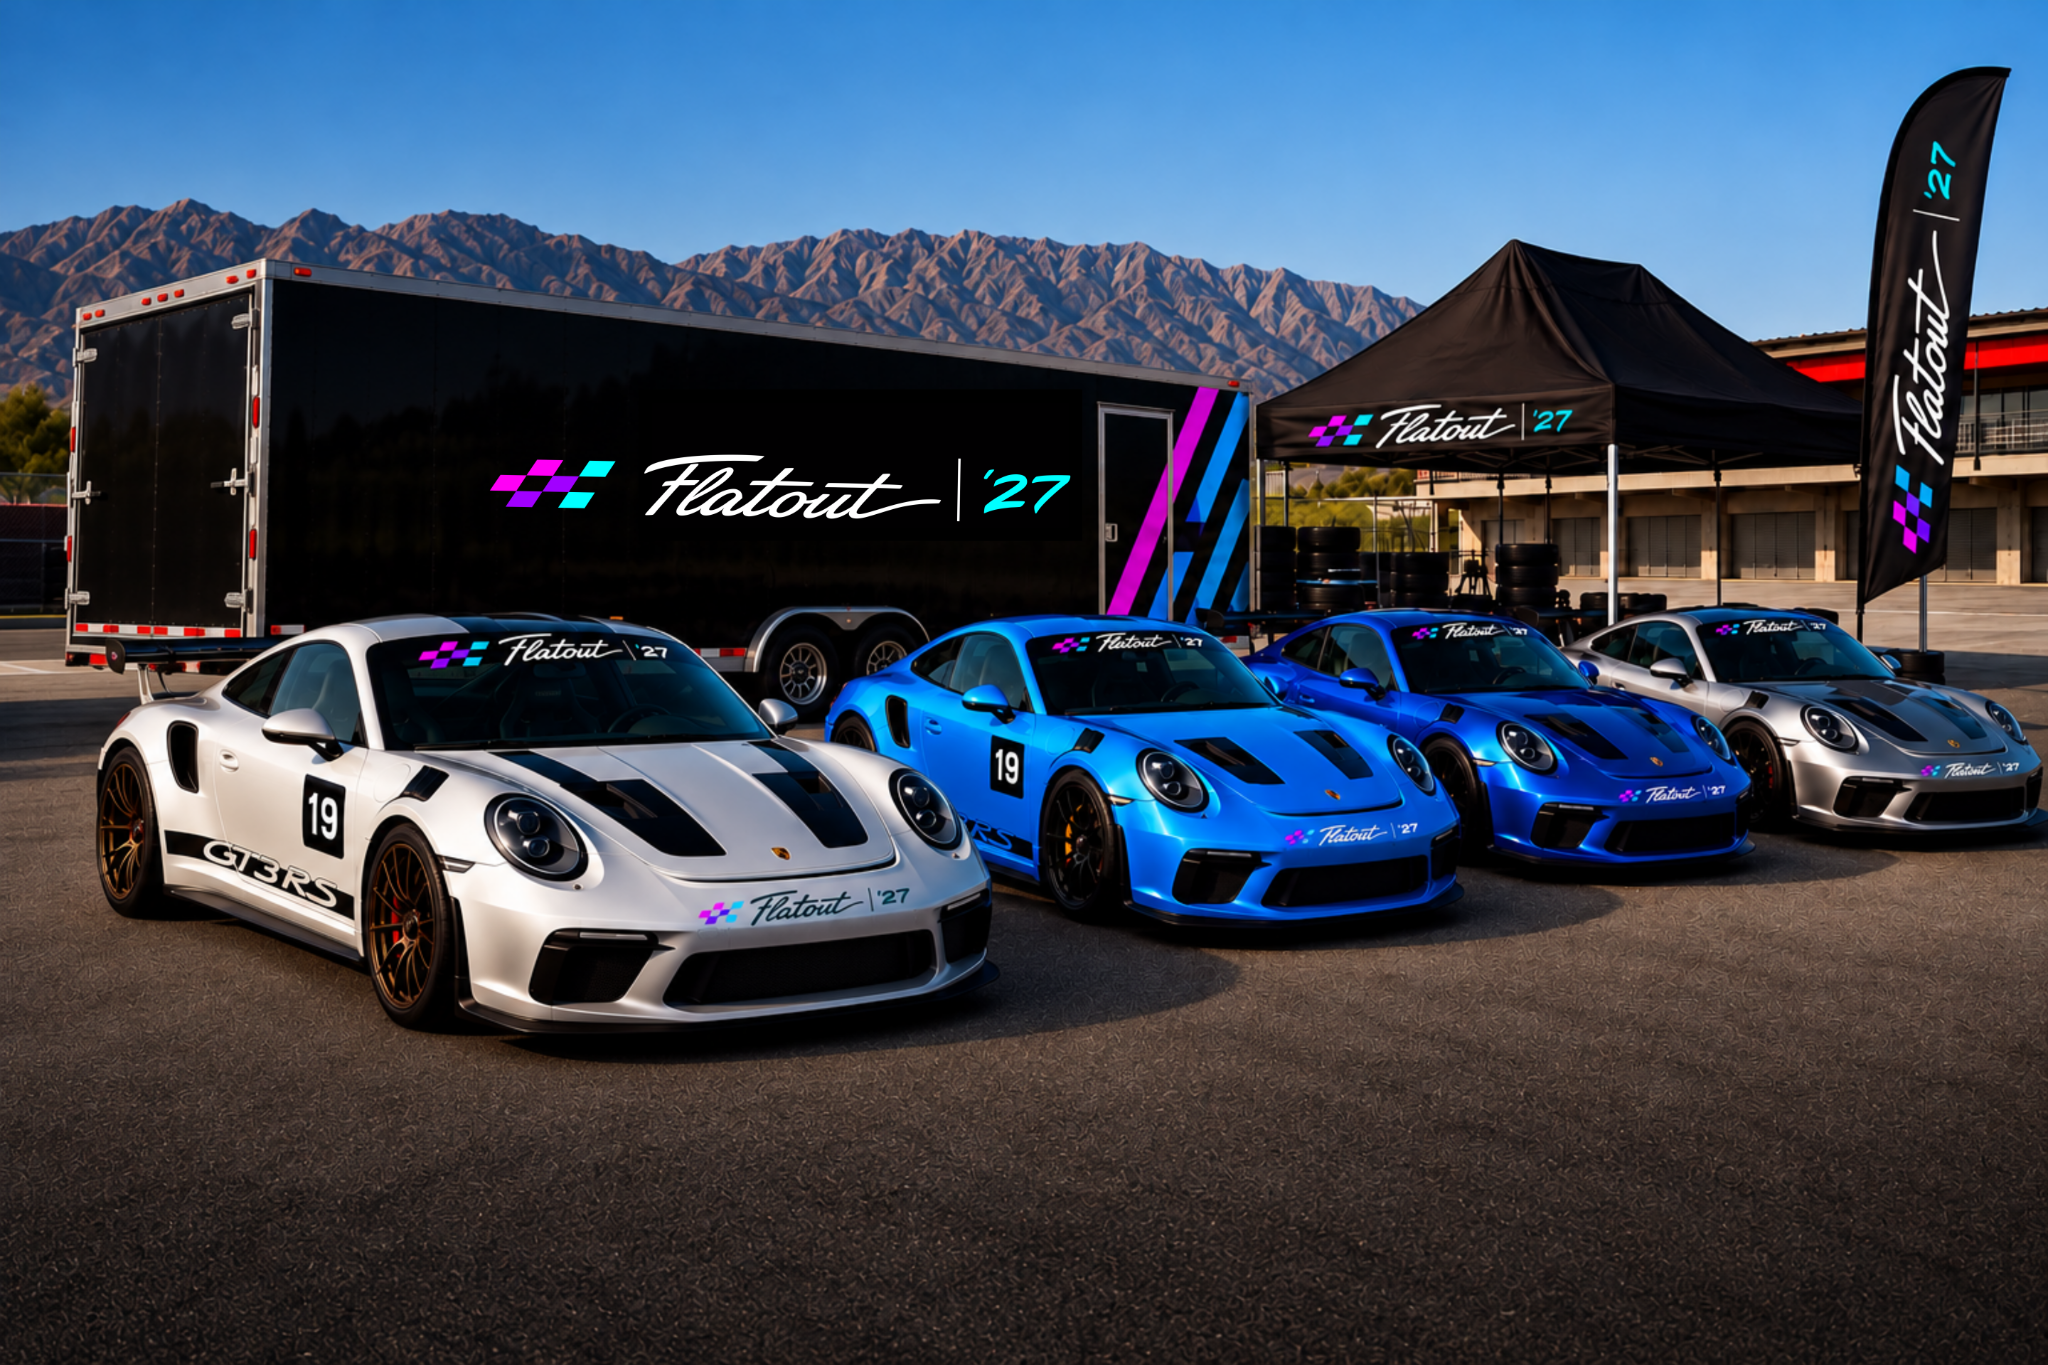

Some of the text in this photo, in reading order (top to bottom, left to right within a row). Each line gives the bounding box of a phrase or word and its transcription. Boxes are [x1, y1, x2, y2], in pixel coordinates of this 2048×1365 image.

[1893, 141, 1956, 465] Flatout '27
[1376, 403, 1573, 449] Flatout '27
[644, 454, 1071, 519] Flatout '27
[499, 633, 668, 666] Flatout '27
[1096, 632, 1172, 652] Flatout
[995, 749, 1019, 784] 19
[308, 793, 338, 840] 19
[1319, 825, 1388, 846] Flatout
[750, 888, 910, 926] Flatout '27
